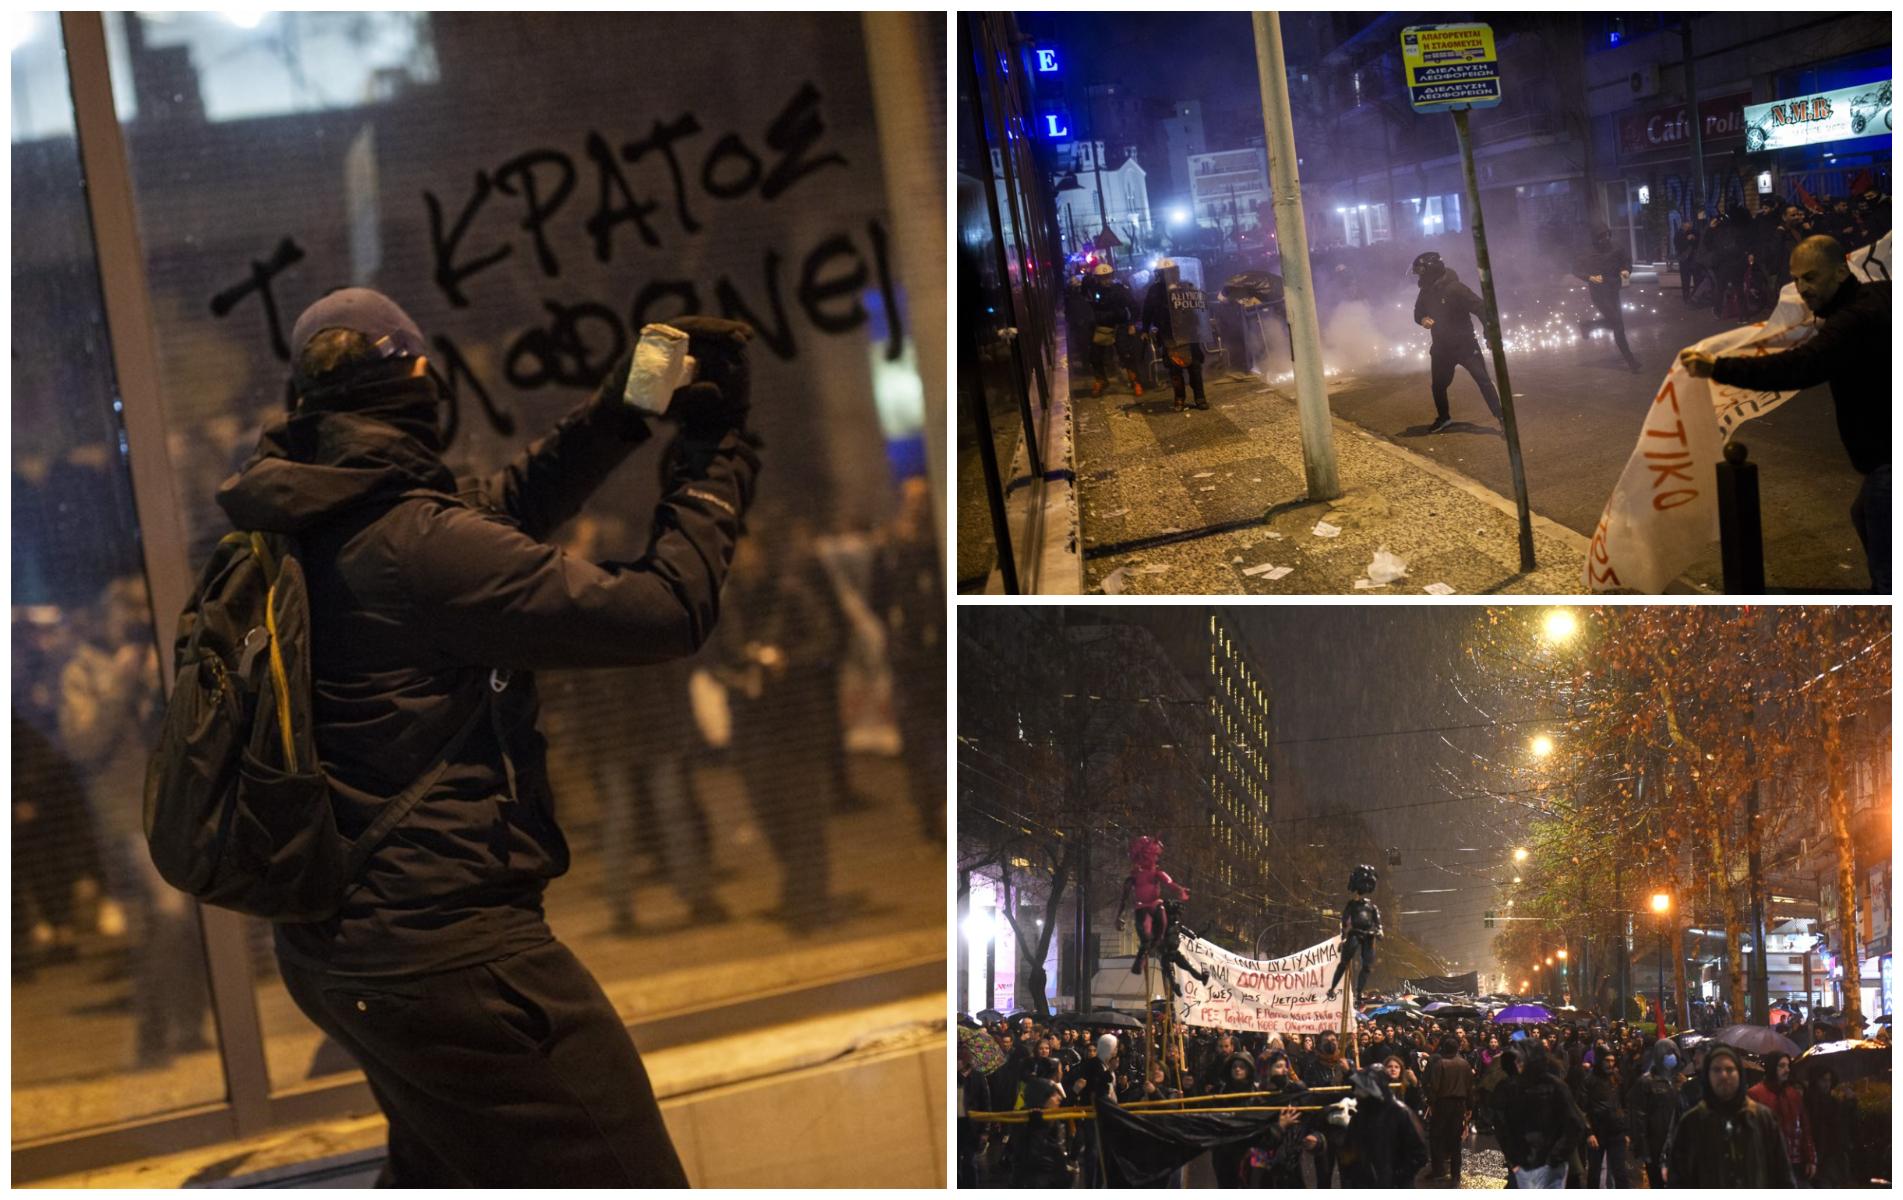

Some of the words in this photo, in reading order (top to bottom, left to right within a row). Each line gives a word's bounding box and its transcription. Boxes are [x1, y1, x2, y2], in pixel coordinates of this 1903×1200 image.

[1421, 30, 1482, 41] ΑΠΑΓΟΡΕΥΕΤΑΙ
[1431, 39, 1483, 50] ΣΤΑΘΜΕΥΣΗ
[1425, 64, 1488, 75] ΔΙΕΛΕΥΣΗ
[1419, 70, 1495, 82] ΛΕΩΦΟΡΕΙΩΝ
[1418, 88, 1493, 100] ΛΕΩΦΟΡΕΙΩΝ
[1424, 83, 1487, 94] ΔΙΕΛΕΥΣΗ
[423, 80, 850, 308] ΚΡΑΤΟΣ
[1268, 943, 1338, 972] ΔΥΣΤΥΧΗΜΑ
[1237, 965, 1325, 990] ΔΟΛΟΦΟΝΙΑ!
